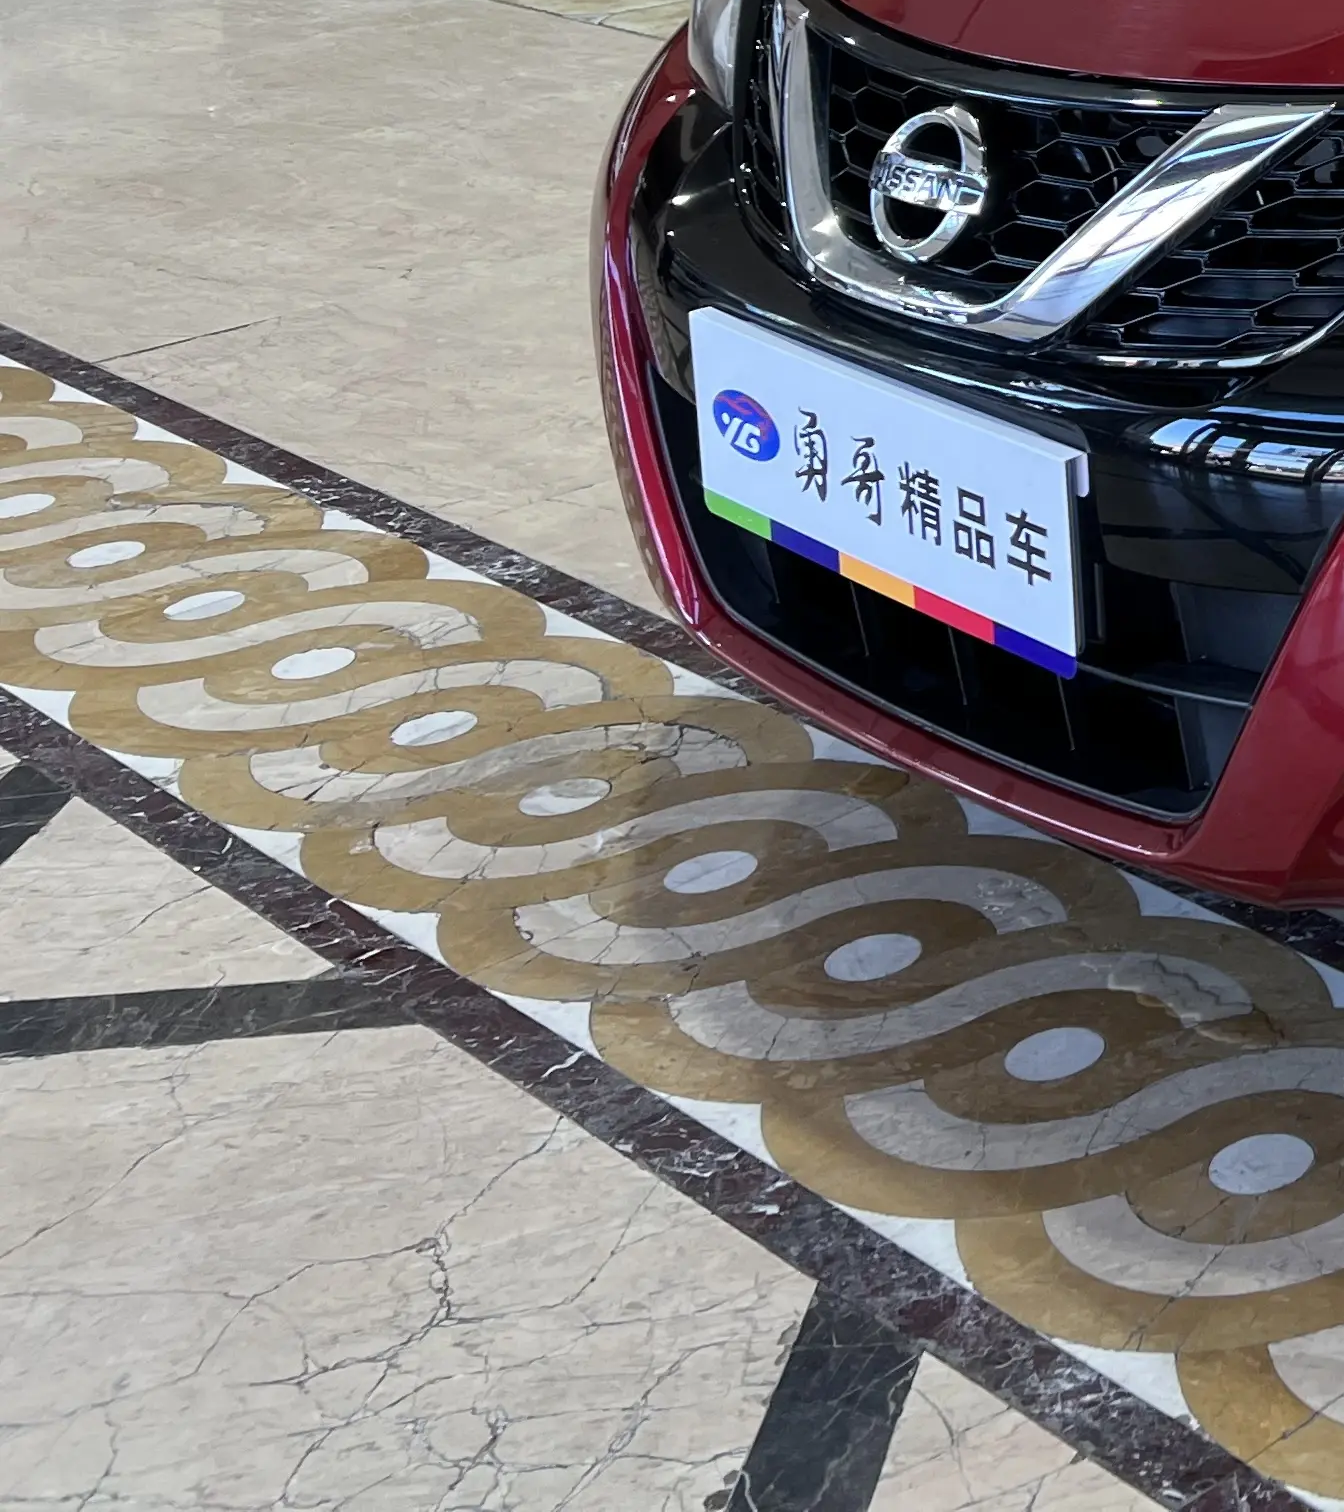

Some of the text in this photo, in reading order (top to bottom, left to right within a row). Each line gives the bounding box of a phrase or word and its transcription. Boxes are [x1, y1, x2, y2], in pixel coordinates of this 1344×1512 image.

[871, 162, 960, 203] NISSAN
[793, 406, 1054, 587] 勇哥精品车
